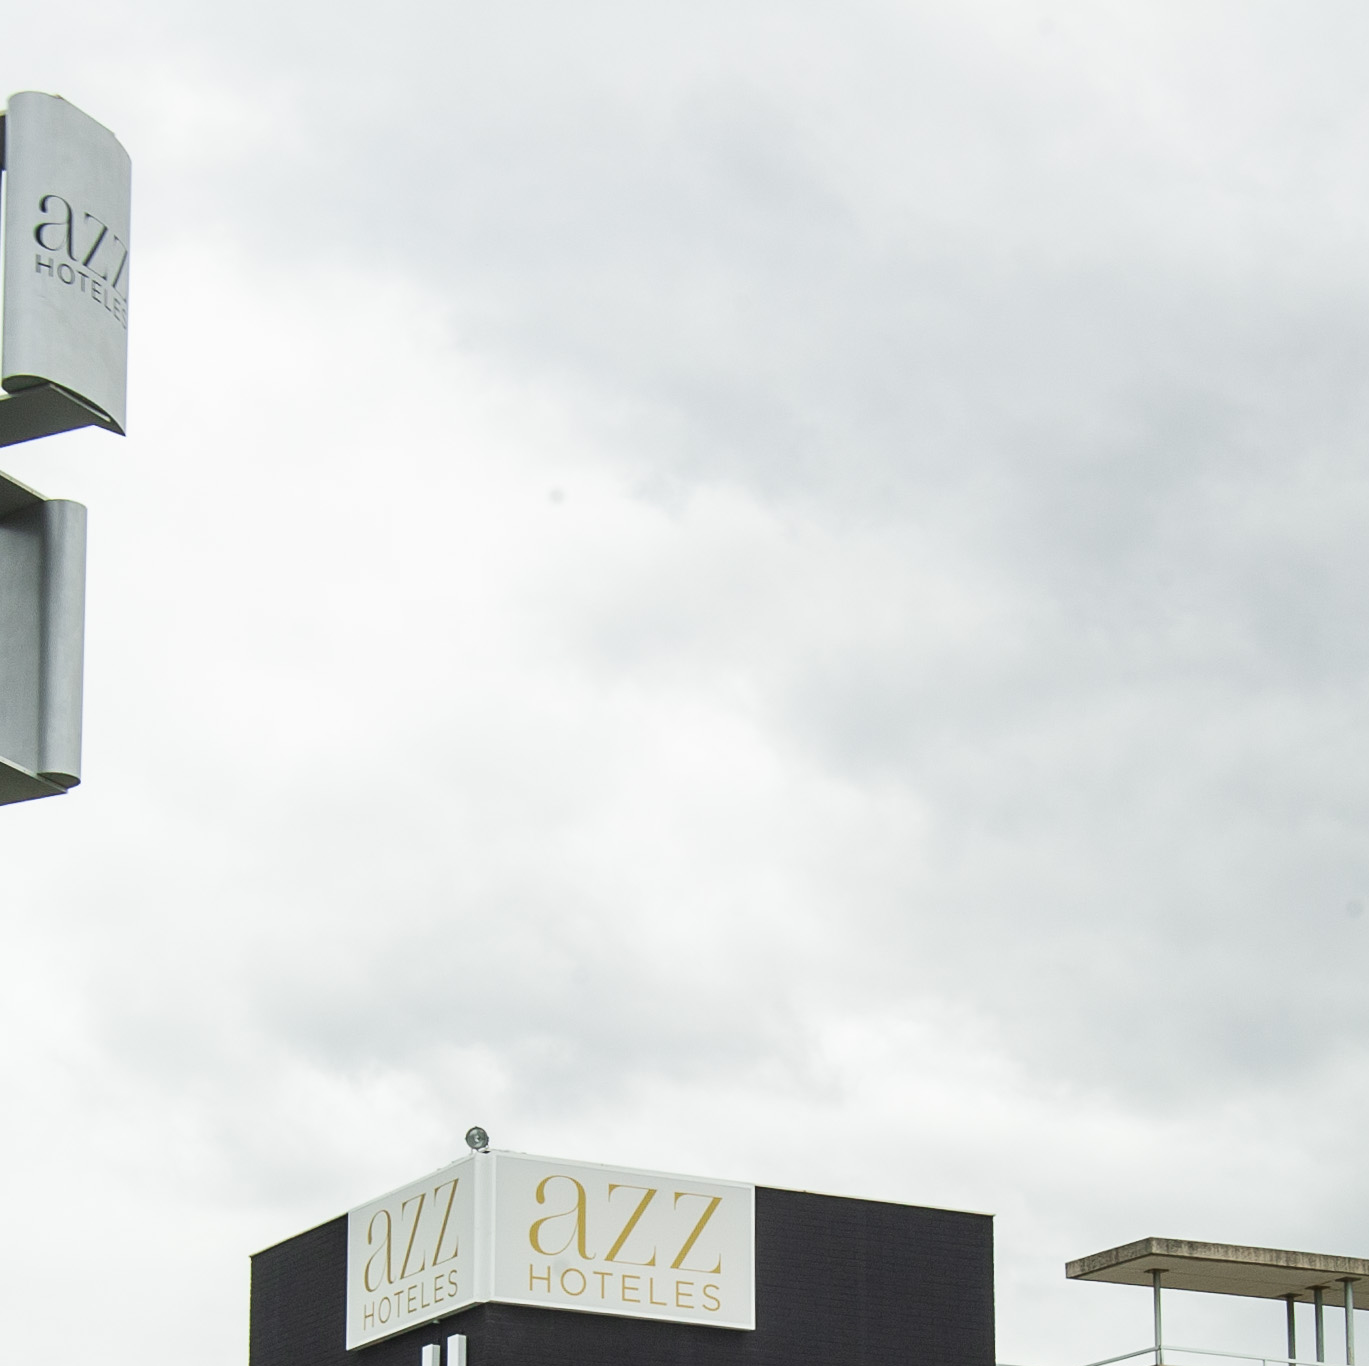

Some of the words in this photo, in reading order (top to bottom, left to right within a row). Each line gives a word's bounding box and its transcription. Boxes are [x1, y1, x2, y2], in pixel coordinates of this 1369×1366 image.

[364, 1178, 460, 1293] azz
[529, 1174, 723, 1275] azz
[363, 1269, 460, 1331] HOTELES
[528, 1263, 722, 1312] HOTELES
